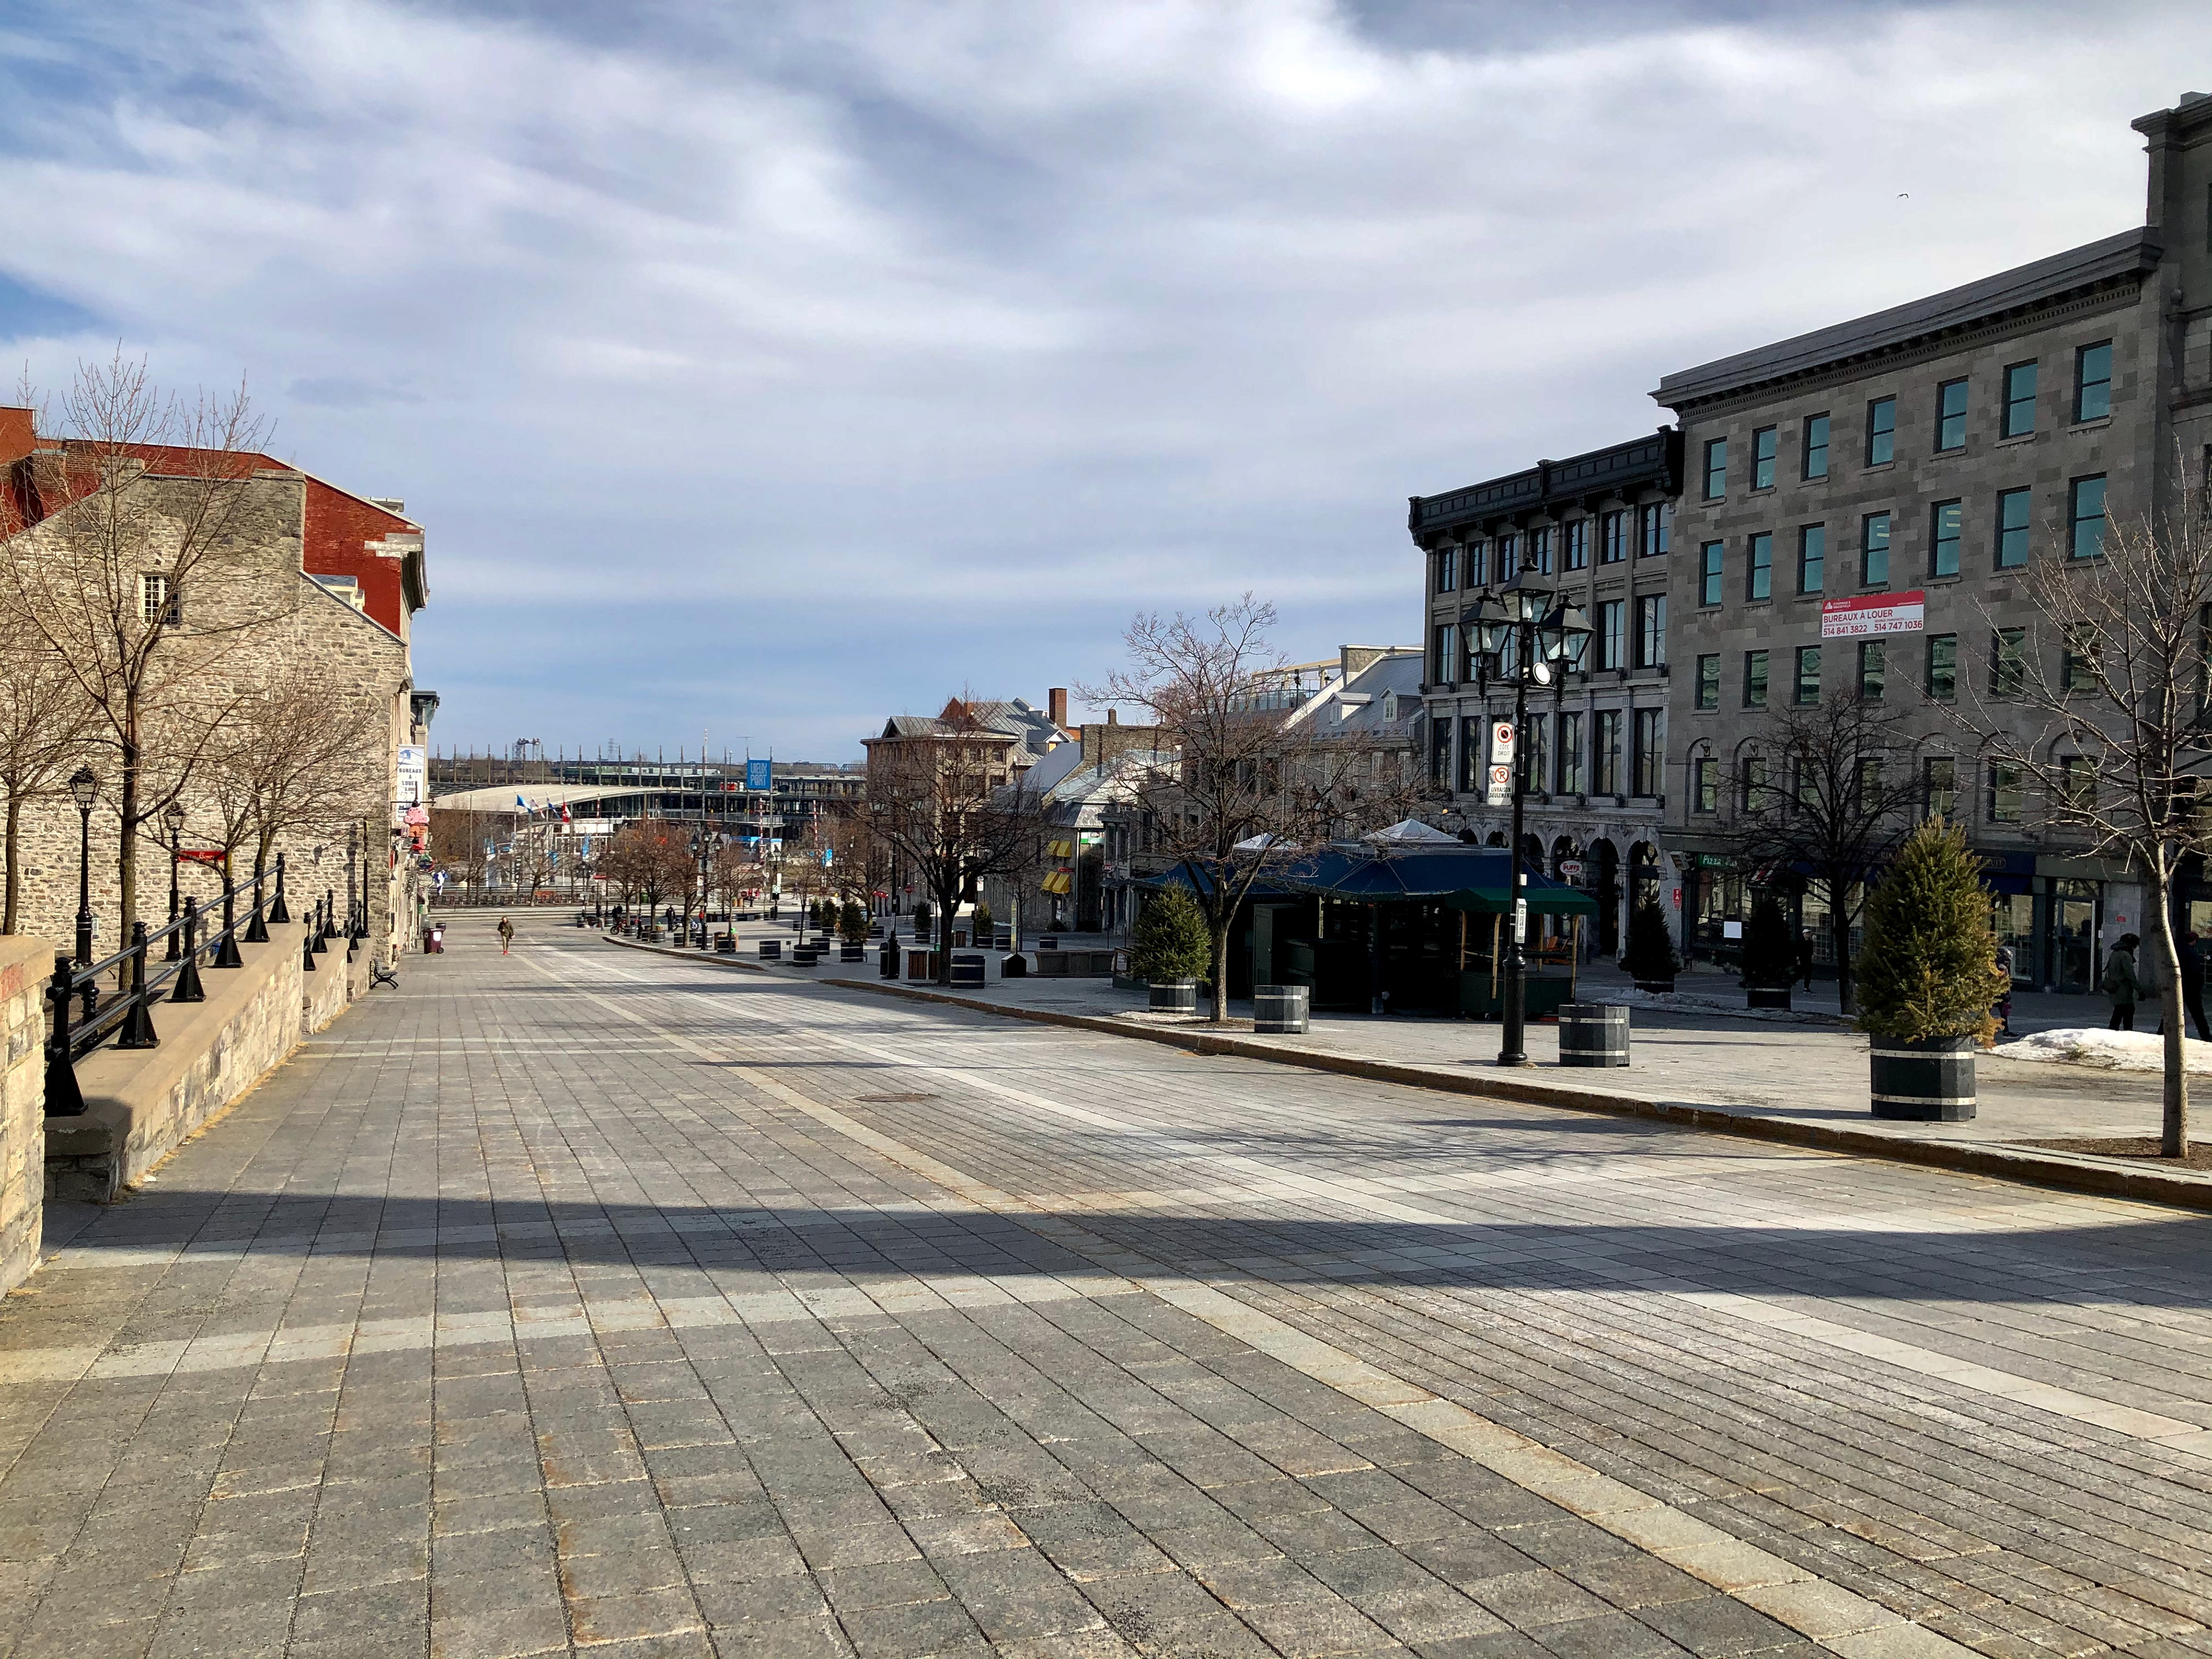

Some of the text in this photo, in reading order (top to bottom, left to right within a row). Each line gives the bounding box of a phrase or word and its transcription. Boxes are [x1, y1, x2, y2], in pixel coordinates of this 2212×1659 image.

[1824, 609, 1893, 623] BUREAUX À LOUER
[1824, 627, 1835, 635] 514
[1836, 626, 1848, 634] 841
[1850, 624, 1867, 633] 3822
[1874, 620, 1922, 631] 514 747 1036
[751, 763, 767, 774] VIEUX
[751, 774, 767, 786] PORT
